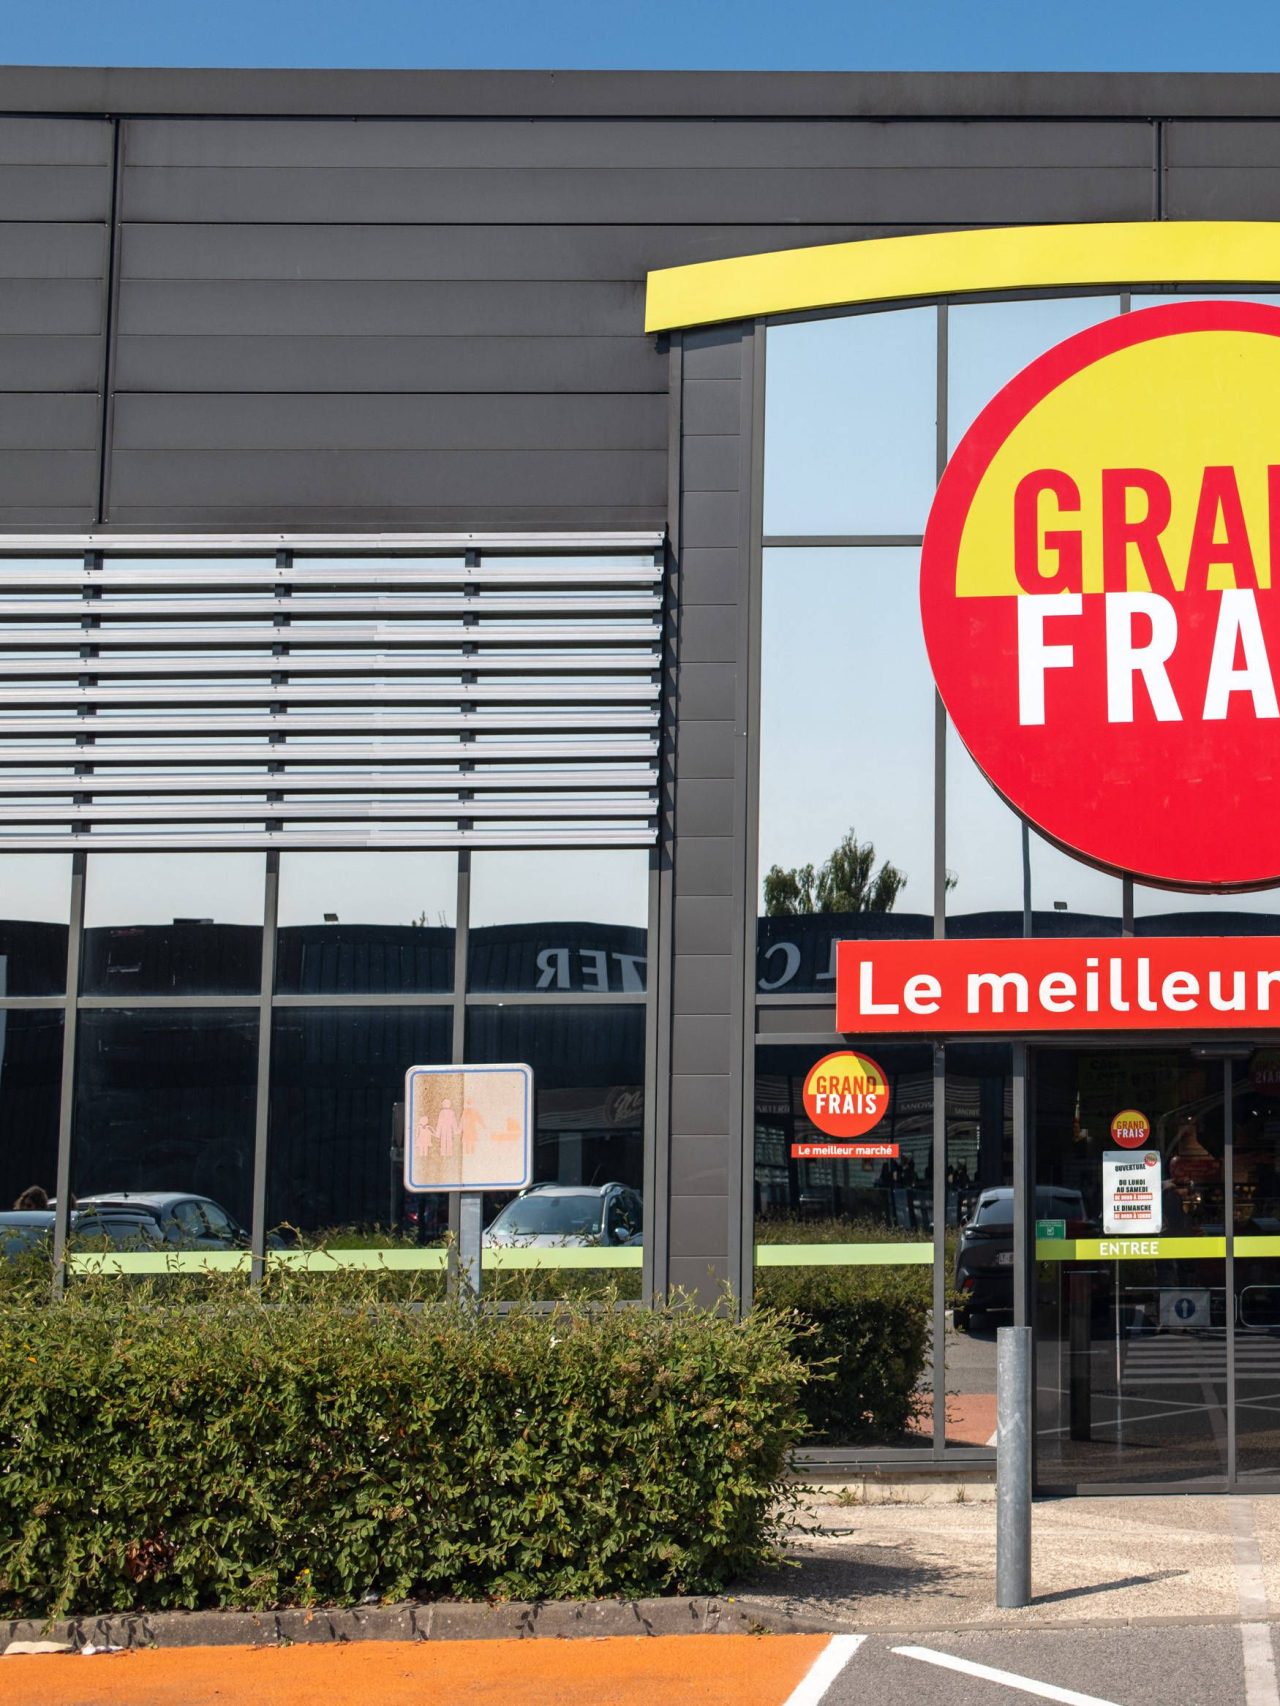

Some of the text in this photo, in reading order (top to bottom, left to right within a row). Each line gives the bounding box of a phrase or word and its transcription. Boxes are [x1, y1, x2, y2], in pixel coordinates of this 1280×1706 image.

[859, 960, 943, 1016] Le
[816, 1075, 878, 1095] GRAND
[816, 1093, 877, 1115] FRAIS
[1116, 1120, 1145, 1130] GRAND
[1117, 1128, 1145, 1138] FRAIS
[798, 1144, 893, 1156] Le meilleur marché
[1114, 1163, 1147, 1172] OUVERTURE
[1121, 1204, 1152, 1212] DIMANCHE
[1099, 1241, 1159, 1256] ENTREE
